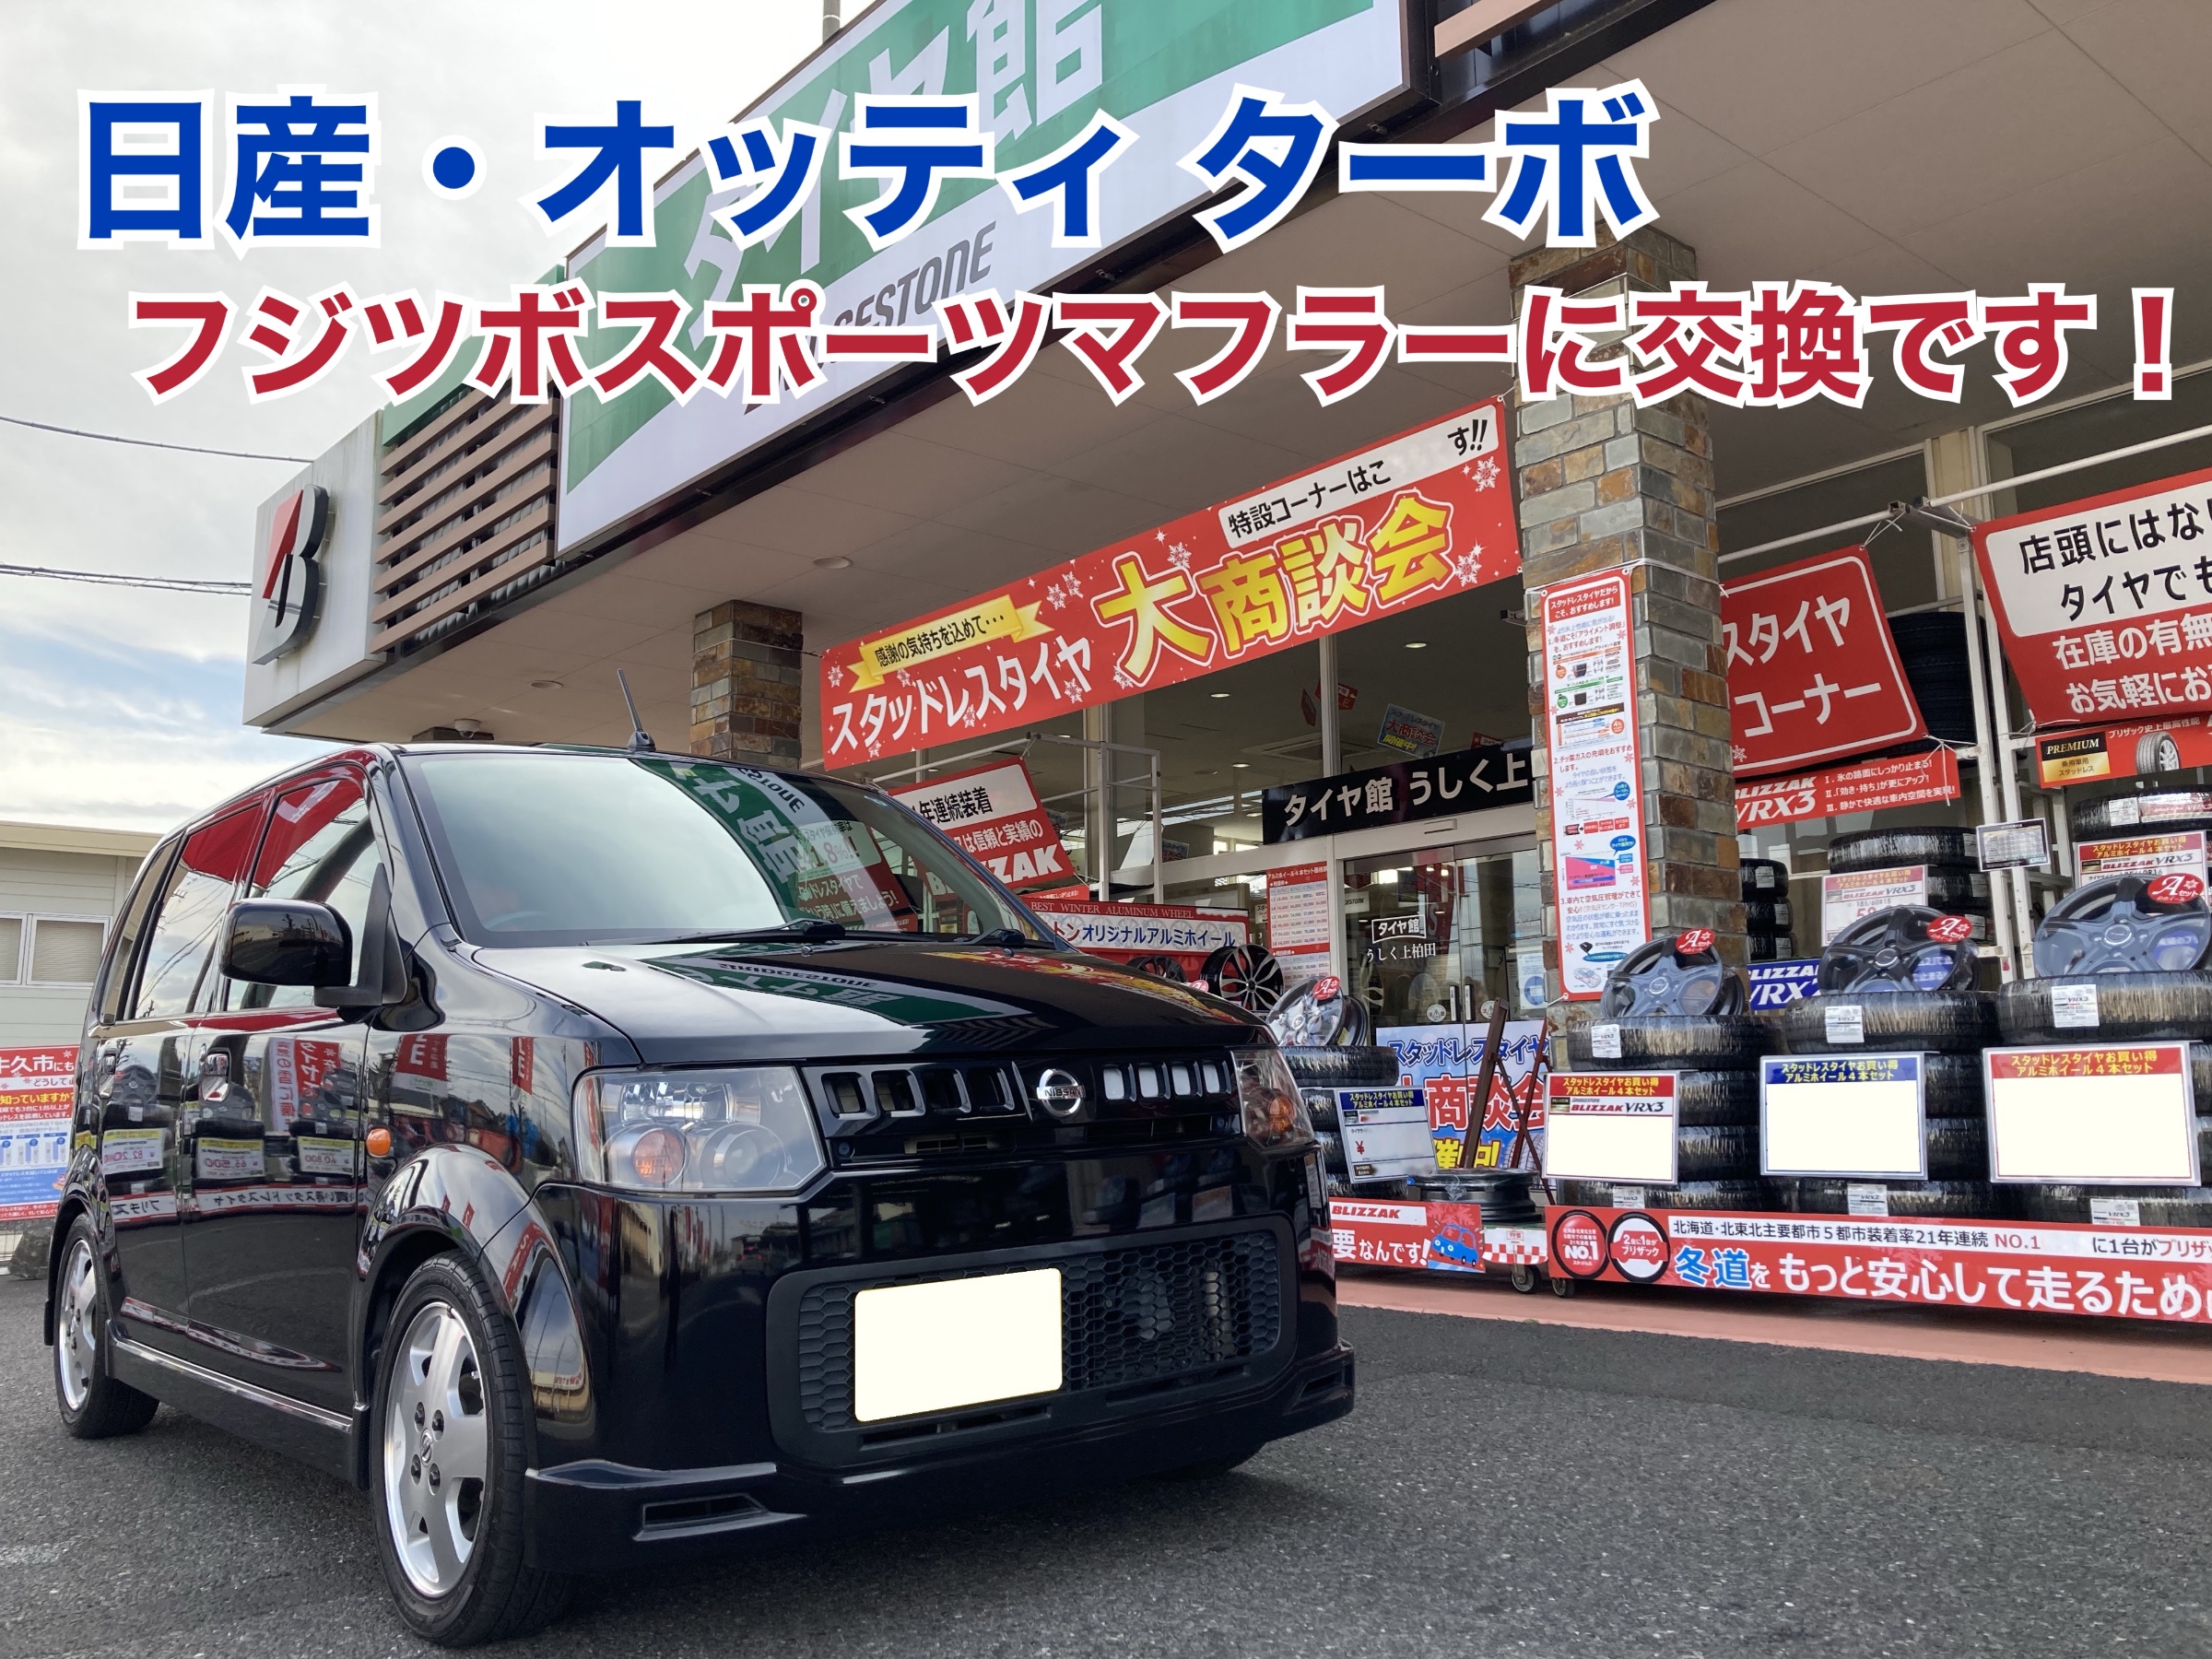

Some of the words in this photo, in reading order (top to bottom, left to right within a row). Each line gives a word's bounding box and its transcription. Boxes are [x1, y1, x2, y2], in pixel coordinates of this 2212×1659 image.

[1227, 459, 1392, 538] 特設コーナーはこ
[2019, 497, 2212, 575] 店頭にはな
[830, 634, 1092, 756] スタッドレスタイヤ
[1093, 492, 1453, 682] 大商談会
[2065, 664, 2212, 714] お気軽にお
[1734, 673, 1882, 737] コーナー
[1385, 718, 1437, 747] 大商談会
[2109, 716, 2201, 739] ブリザック史上最高性能
[2046, 738, 2100, 755] PREMIUM
[2059, 766, 2094, 777] スタッドレス
[1284, 776, 1394, 827] タイヤ館
[1409, 753, 1528, 806] うしく上
[912, 786, 994, 825] 年連続装着
[2156, 853, 2194, 865] VRX3
[1886, 884, 1915, 895] VRX3
[1031, 901, 1054, 912] BEST
[1060, 903, 1100, 914] WINTER
[1106, 906, 1160, 918] ALUMINUM
[1160, 909, 1194, 919] WHEEL
[1378, 918, 1420, 936] タイヤ館
[1366, 943, 1436, 963] うしく上柏田
[1748, 965, 1818, 981] LIZZA
[1782, 1059, 1899, 1074] スタッドレスタイヤお買い得
[2011, 1050, 2158, 1066] スタッドレスタイヤお買い得
[1562, 1077, 1659, 1088] スタッドレスタイヤお買い得
[1044, 1088, 1082, 1098] NISSAN
[1571, 1104, 1624, 1112] BLIZZAK
[1625, 1101, 1665, 1113] VRX3
[1332, 1206, 1401, 1218] BLIZZAK
[1623, 1233, 1658, 1245] 2台に1台が
[1994, 1233, 2041, 1250] NO.1
[1564, 1241, 1599, 1260] NO.1
[1621, 1245, 1659, 1257] ブリザック
[1779, 1252, 2212, 1319] もっと安心して走るため
